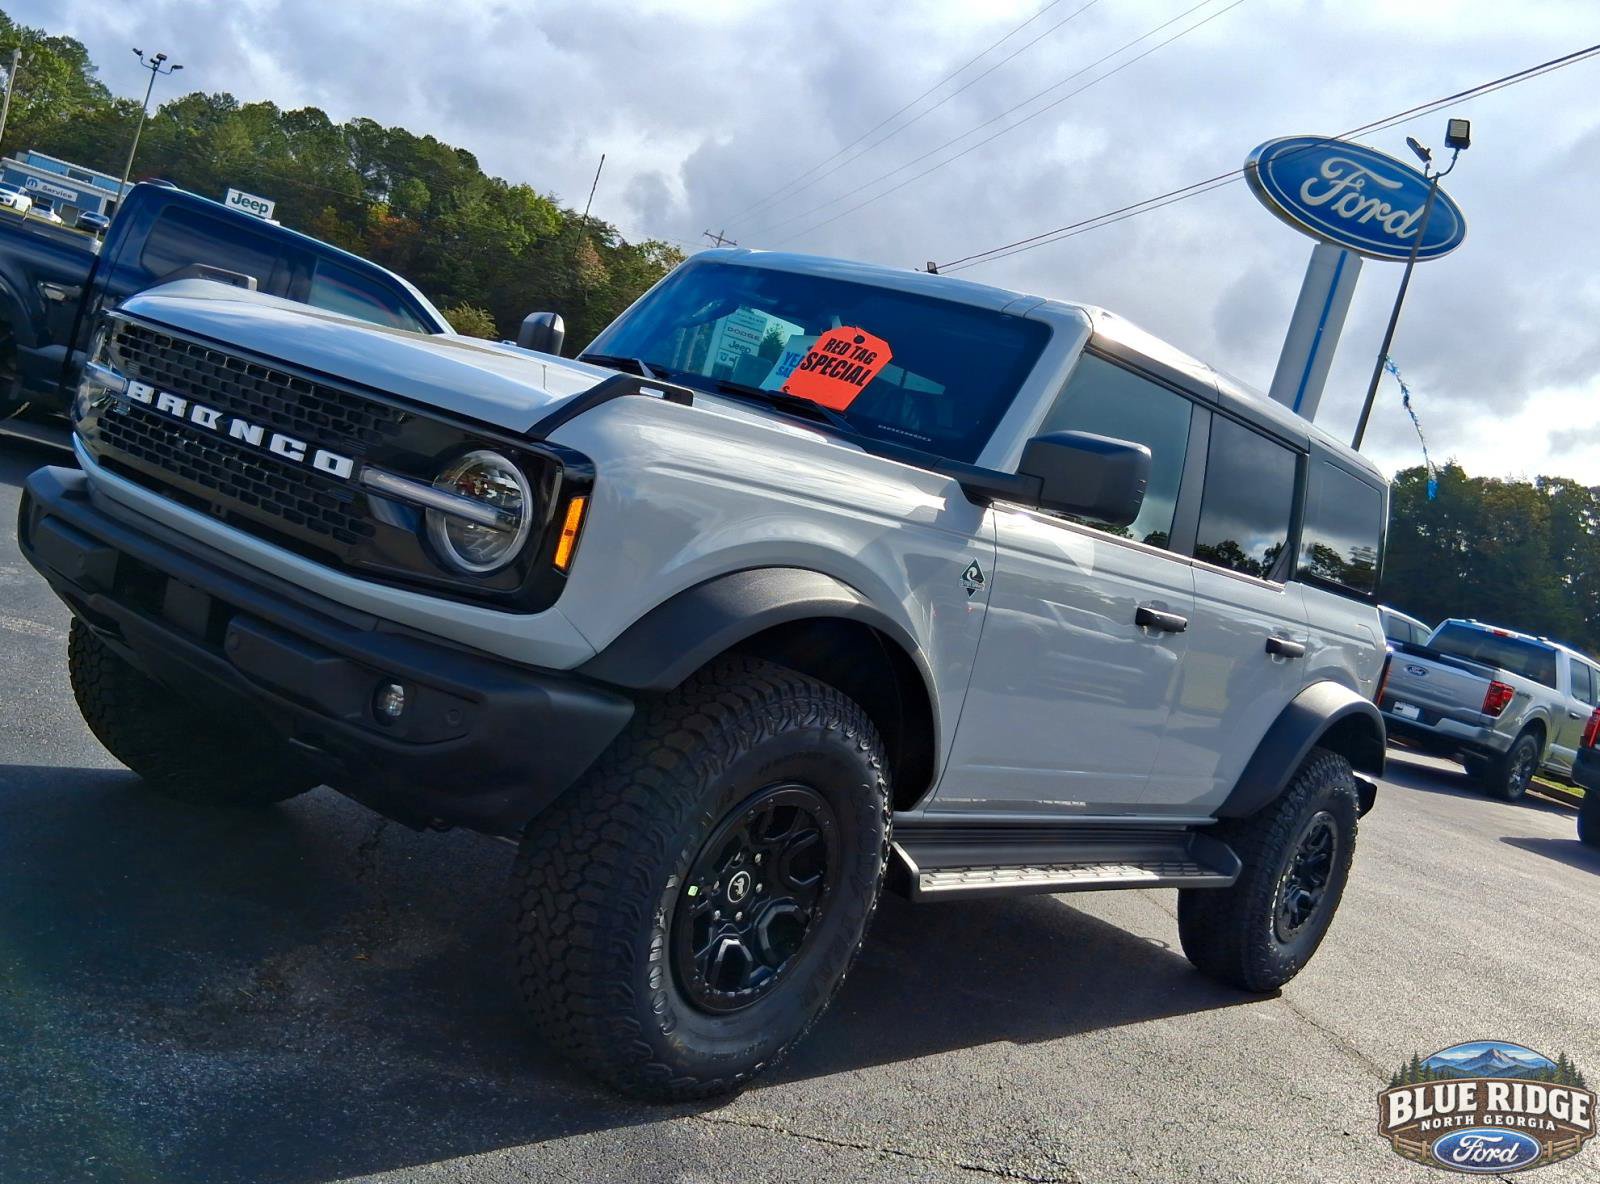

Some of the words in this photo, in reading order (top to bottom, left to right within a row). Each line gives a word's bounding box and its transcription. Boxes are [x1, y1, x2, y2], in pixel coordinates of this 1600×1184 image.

[41, 184, 73, 199] Service
[231, 192, 269, 215] Jeep
[1300, 157, 1426, 239] Ford
[822, 337, 851, 357] RED
[850, 344, 878, 366] TAG
[800, 350, 873, 388] SPECIAL
[126, 380, 354, 480] BRONCO
